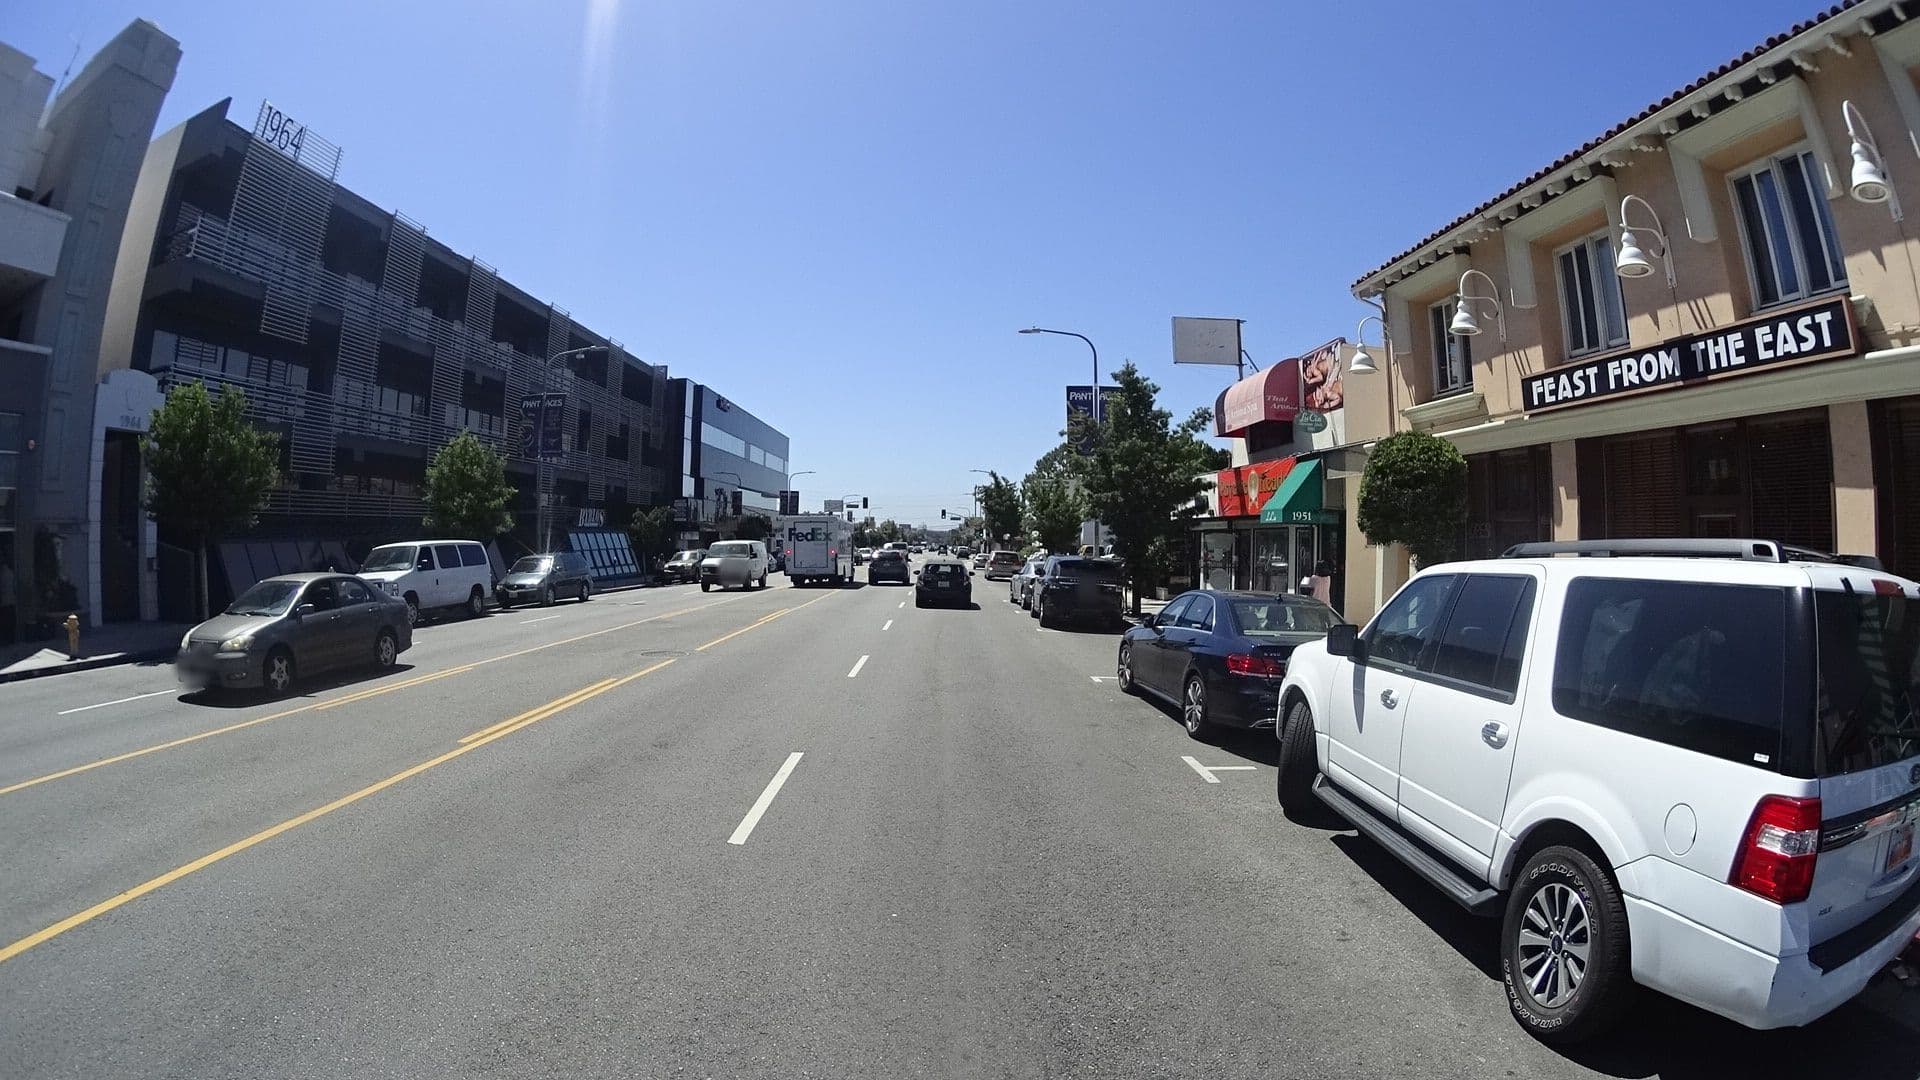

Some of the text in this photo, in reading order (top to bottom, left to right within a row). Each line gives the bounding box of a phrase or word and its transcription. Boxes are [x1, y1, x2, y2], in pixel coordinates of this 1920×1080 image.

[261, 105, 304, 157] 1964
[1531, 311, 1833, 406] FEAST FROM THE EAST
[788, 528, 832, 542] FedEx
[1292, 511, 1312, 521] 1951
[1529, 862, 1599, 937] GOODYEAR
